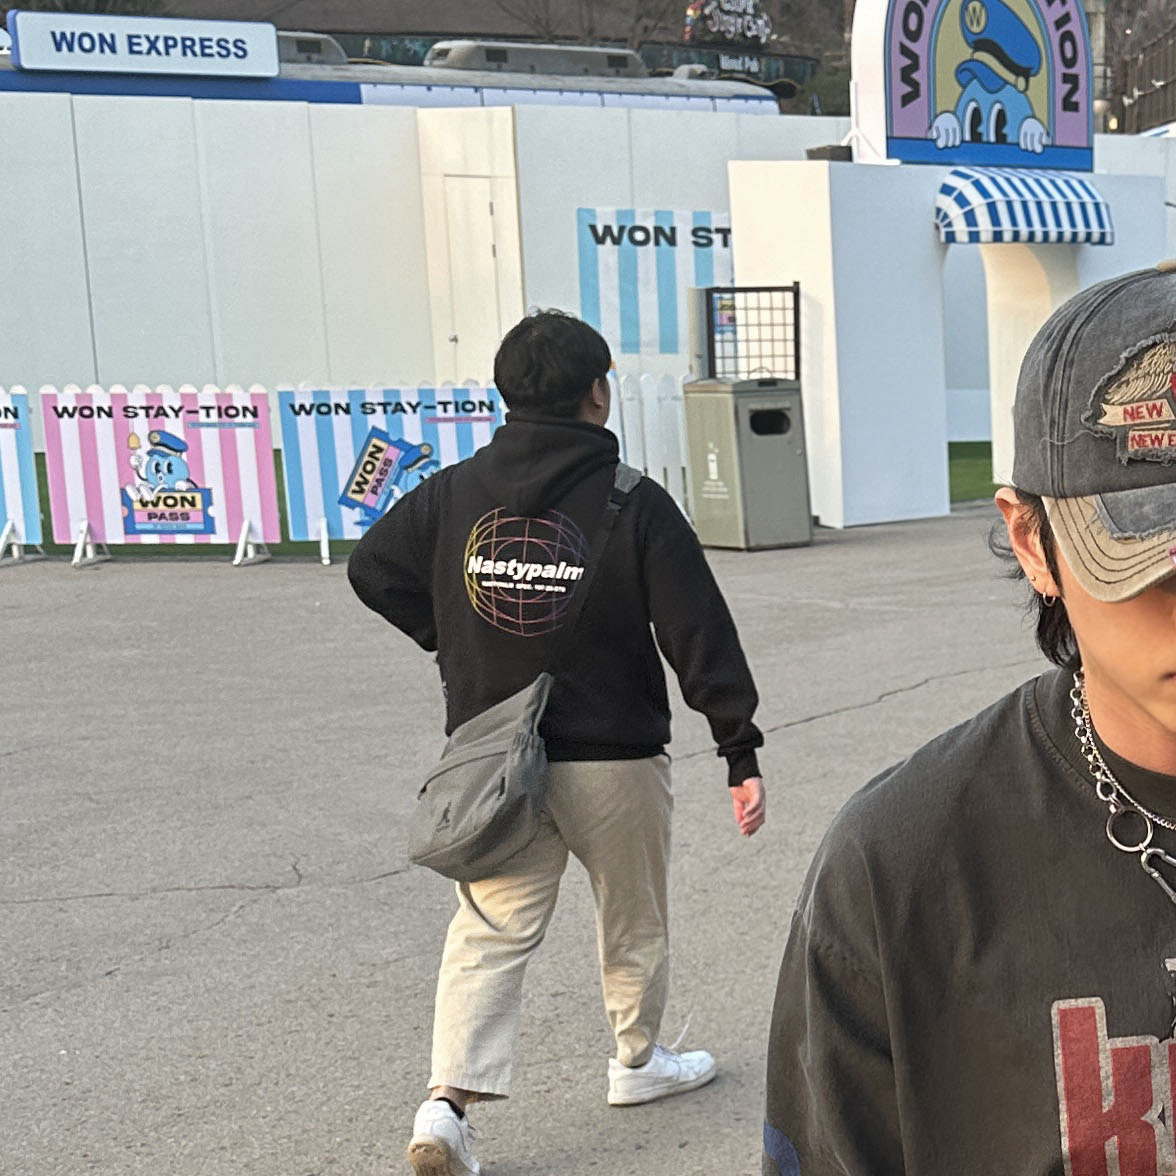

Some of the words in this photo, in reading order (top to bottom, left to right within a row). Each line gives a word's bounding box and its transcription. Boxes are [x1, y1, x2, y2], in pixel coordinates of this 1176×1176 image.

[51, 31, 117, 54] WON
[127, 34, 248, 59] EXPRESS
[900, 0, 930, 108] WO
[588, 224, 677, 247] WON
[0, 406, 19, 419] N
[53, 405, 114, 419] WON
[122, 405, 259, 419] STAY-TION
[289, 402, 351, 416] WON
[360, 400, 495, 415] STAY-TION
[1122, 401, 1163, 422] NEW
[1130, 434, 1164, 449] NEW
[351, 443, 386, 497] WON
[370, 457, 393, 497] PASS
[148, 511, 190, 521] PASS
[467, 555, 585, 581] Nastypalm
